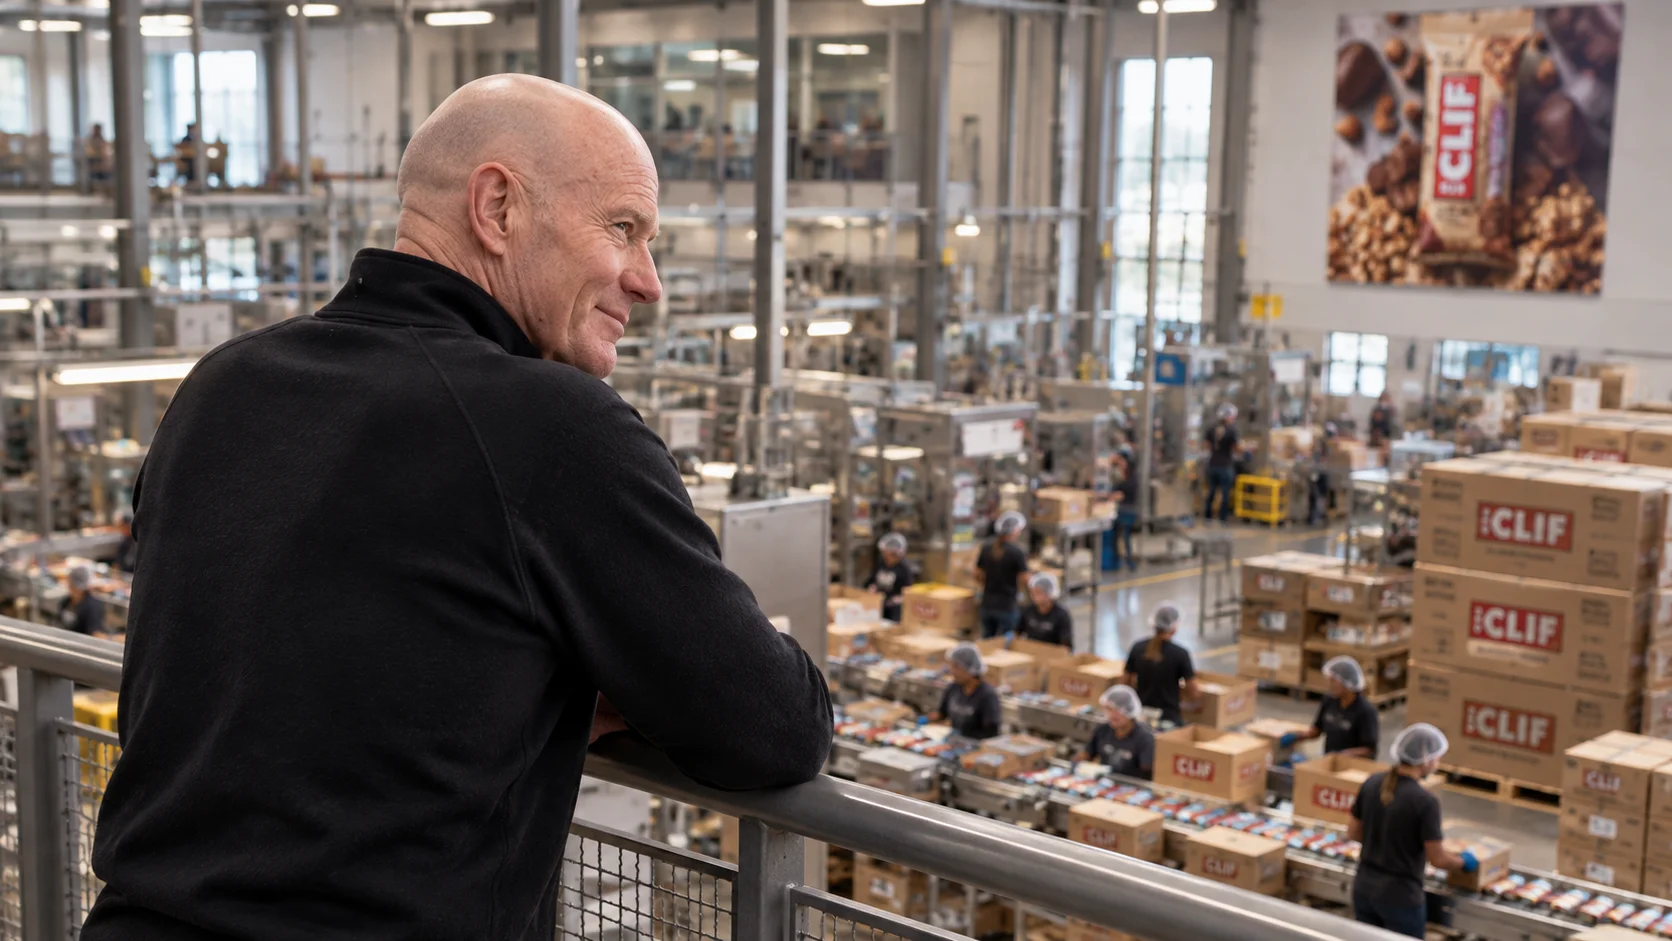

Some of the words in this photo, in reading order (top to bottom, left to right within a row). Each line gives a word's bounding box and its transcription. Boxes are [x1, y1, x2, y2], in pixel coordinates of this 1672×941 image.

[1438, 82, 1475, 182] CLIF
[1491, 507, 1567, 546] CLIF
[1484, 606, 1558, 647] CLIF
[1477, 706, 1549, 747] CLIF
[1176, 756, 1211, 777] CLIF
